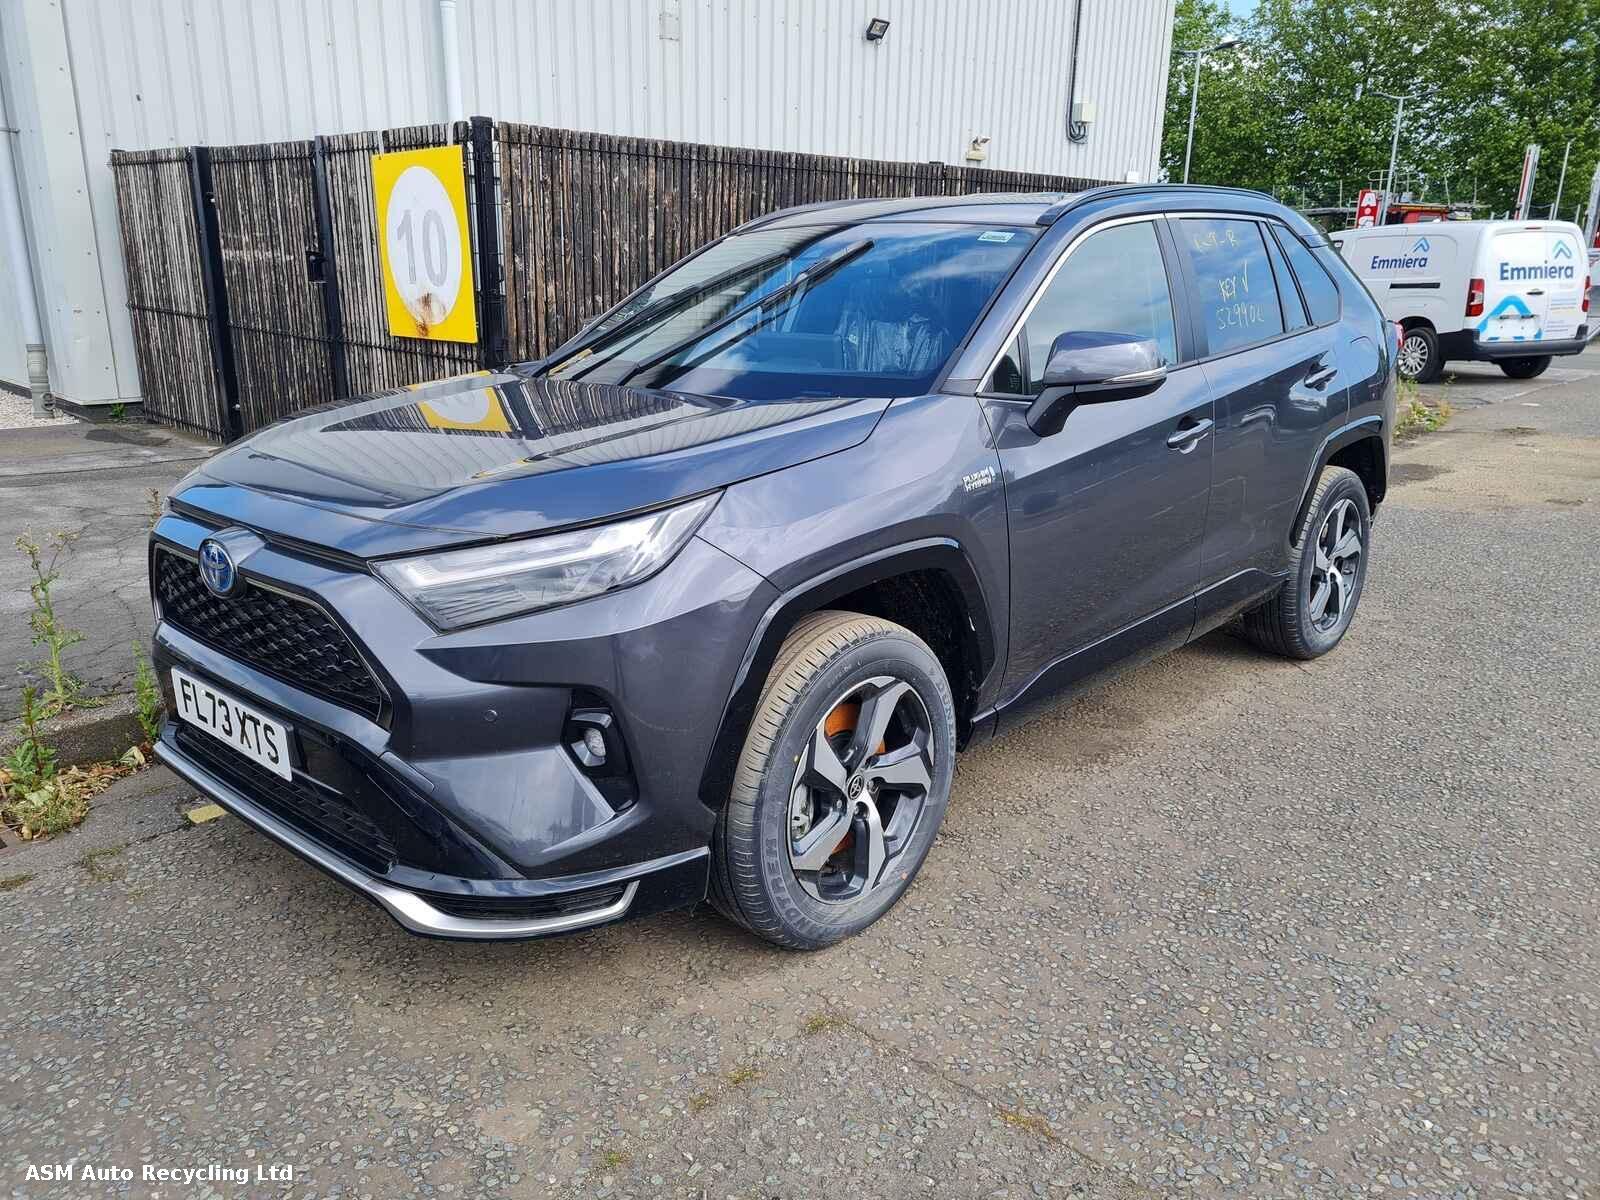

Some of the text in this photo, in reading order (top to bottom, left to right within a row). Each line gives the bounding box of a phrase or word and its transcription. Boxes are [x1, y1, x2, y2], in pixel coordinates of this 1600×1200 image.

[397, 209, 449, 287] 10
[1371, 253, 1428, 269] Emmiera
[1499, 260, 1574, 281] Emmiera
[180, 677, 280, 765] FL73 XTS
